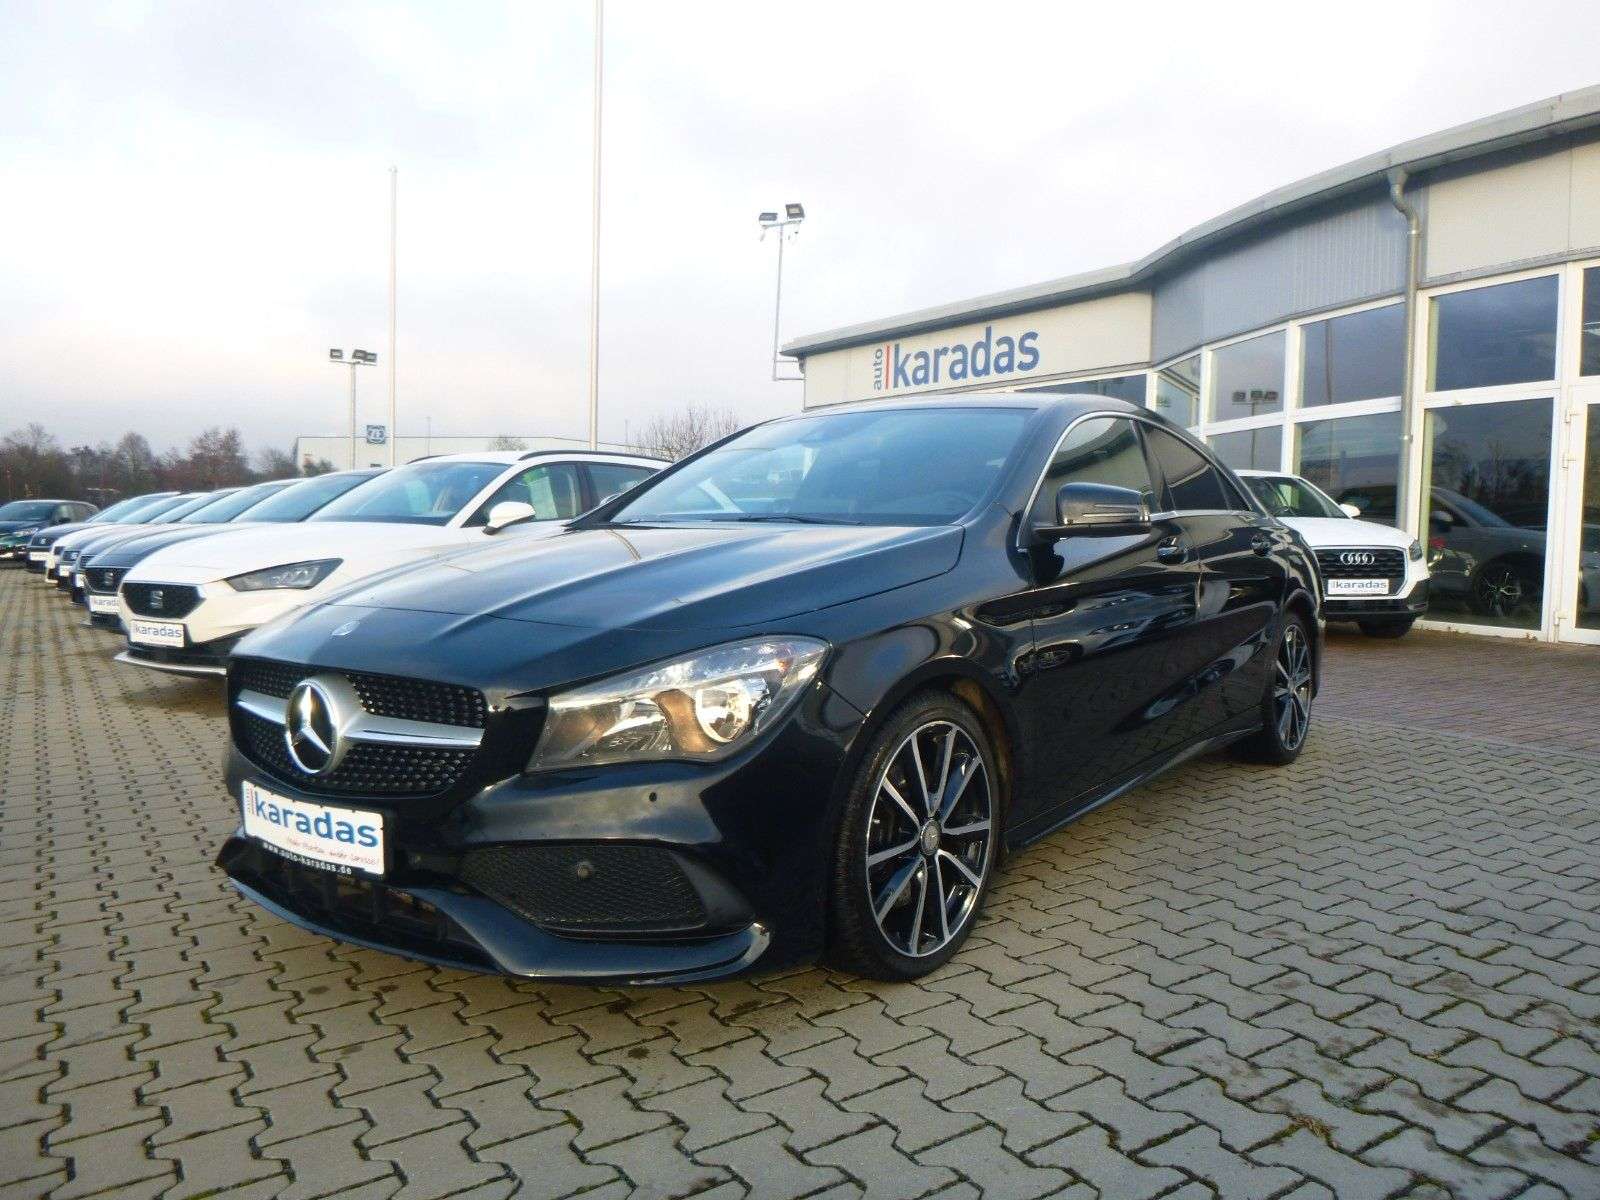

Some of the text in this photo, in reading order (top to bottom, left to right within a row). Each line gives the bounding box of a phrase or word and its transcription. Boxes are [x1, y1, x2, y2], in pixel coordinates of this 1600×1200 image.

[873, 325, 1040, 390] auto karadas
[1335, 581, 1387, 589] karadas
[134, 624, 182, 638] karadas
[255, 791, 379, 848] karadas
